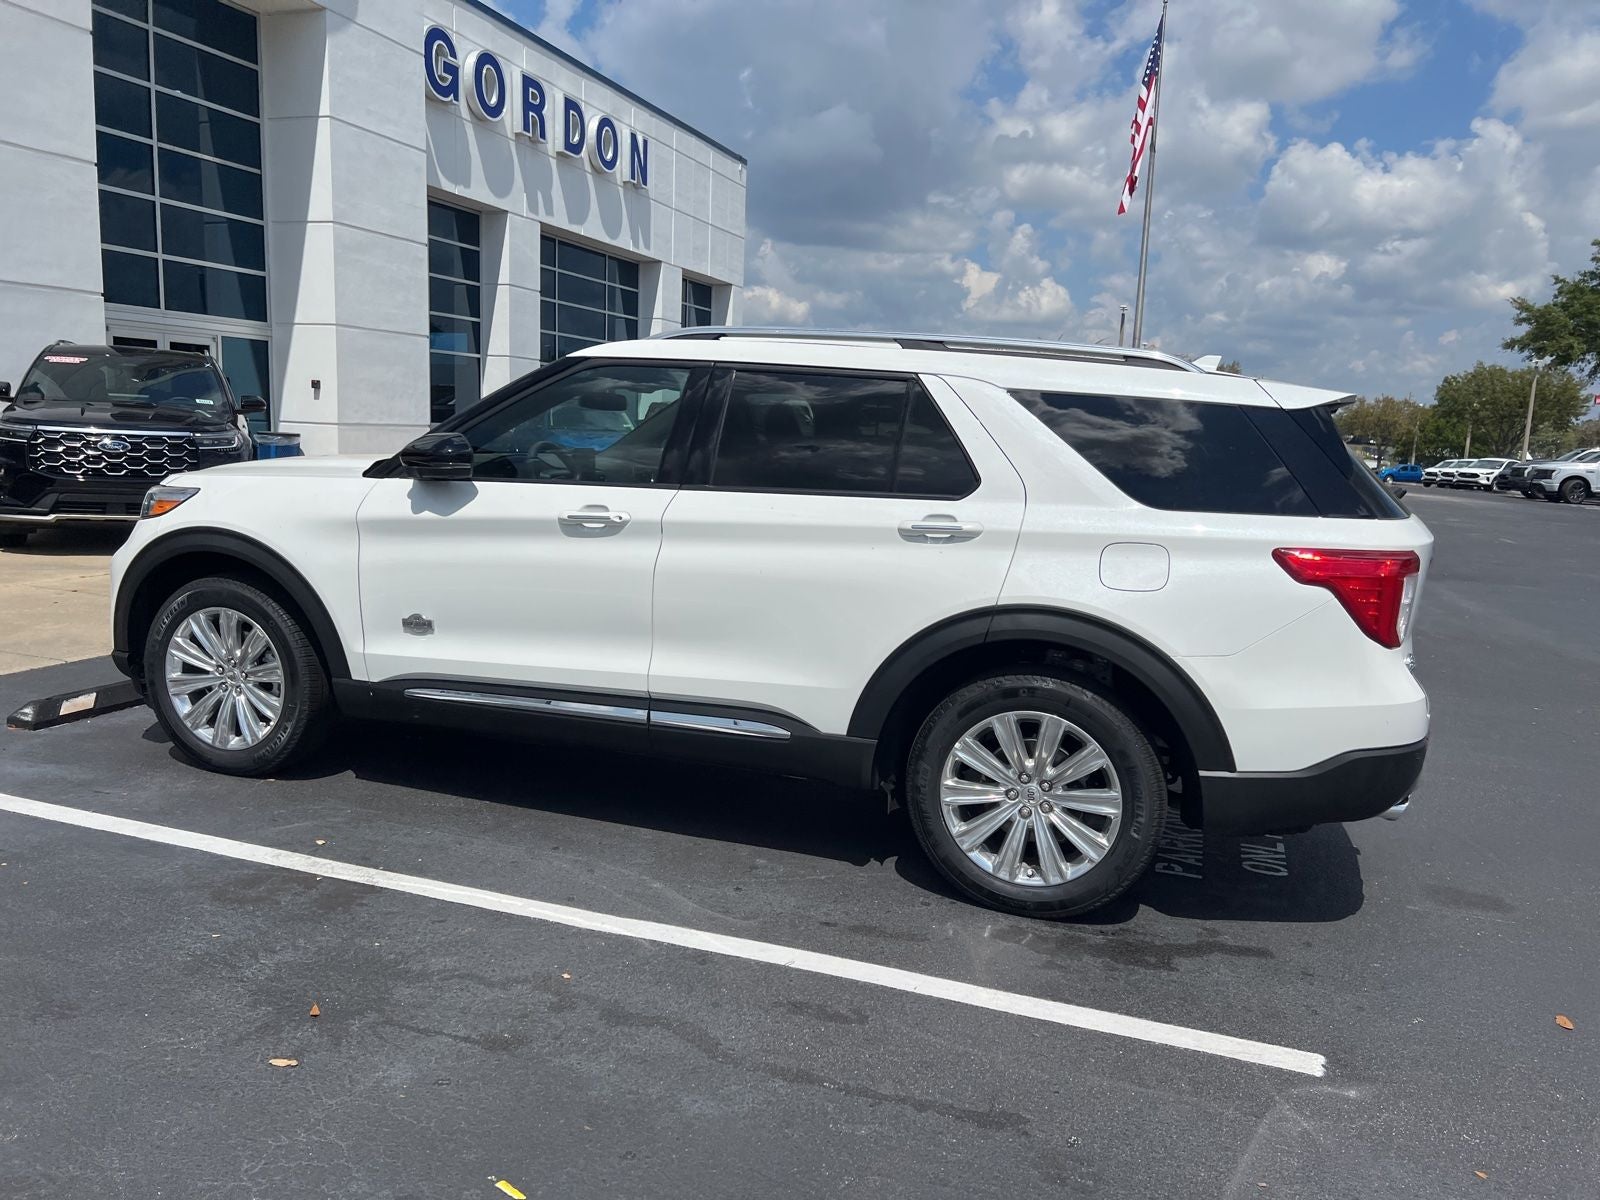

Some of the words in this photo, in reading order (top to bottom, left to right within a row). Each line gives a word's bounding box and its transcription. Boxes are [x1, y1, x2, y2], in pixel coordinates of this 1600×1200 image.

[424, 25, 649, 189] GORDON
[1155, 807, 1203, 879] PARKI
[1240, 834, 1288, 876] ONL
